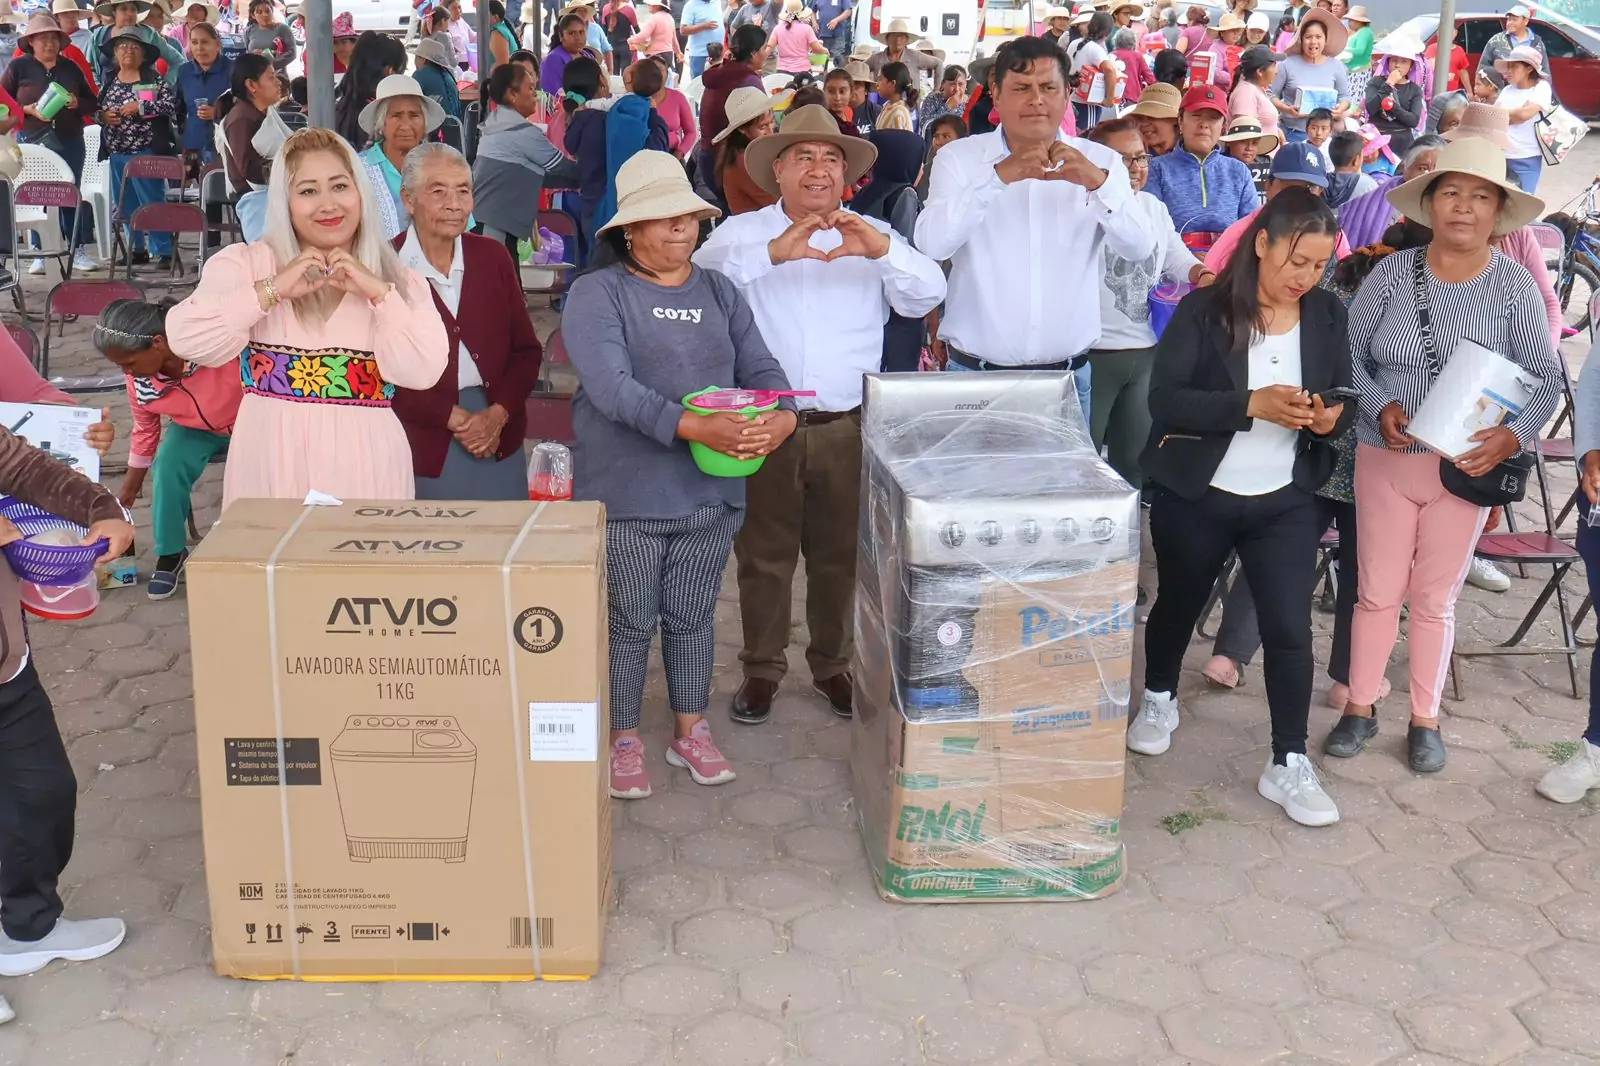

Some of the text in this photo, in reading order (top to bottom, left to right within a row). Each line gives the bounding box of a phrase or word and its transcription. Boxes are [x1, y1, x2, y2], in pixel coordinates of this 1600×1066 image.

[354, 508, 477, 518] ATVIO
[332, 539, 464, 551] ATVIO
[326, 597, 458, 627] ATVIO
[368, 628, 415, 637] HOME
[530, 618, 543, 638] 1
[285, 654, 502, 676] LAVADORA SEMIAUTOMÁTICA
[376, 682, 415, 700] 11KG
[295, 761, 318, 771] impulsor
[891, 873, 906, 890] EL
[911, 876, 976, 890] ORIGINAL
[239, 885, 263, 898] NOM
[326, 921, 338, 935] 3
